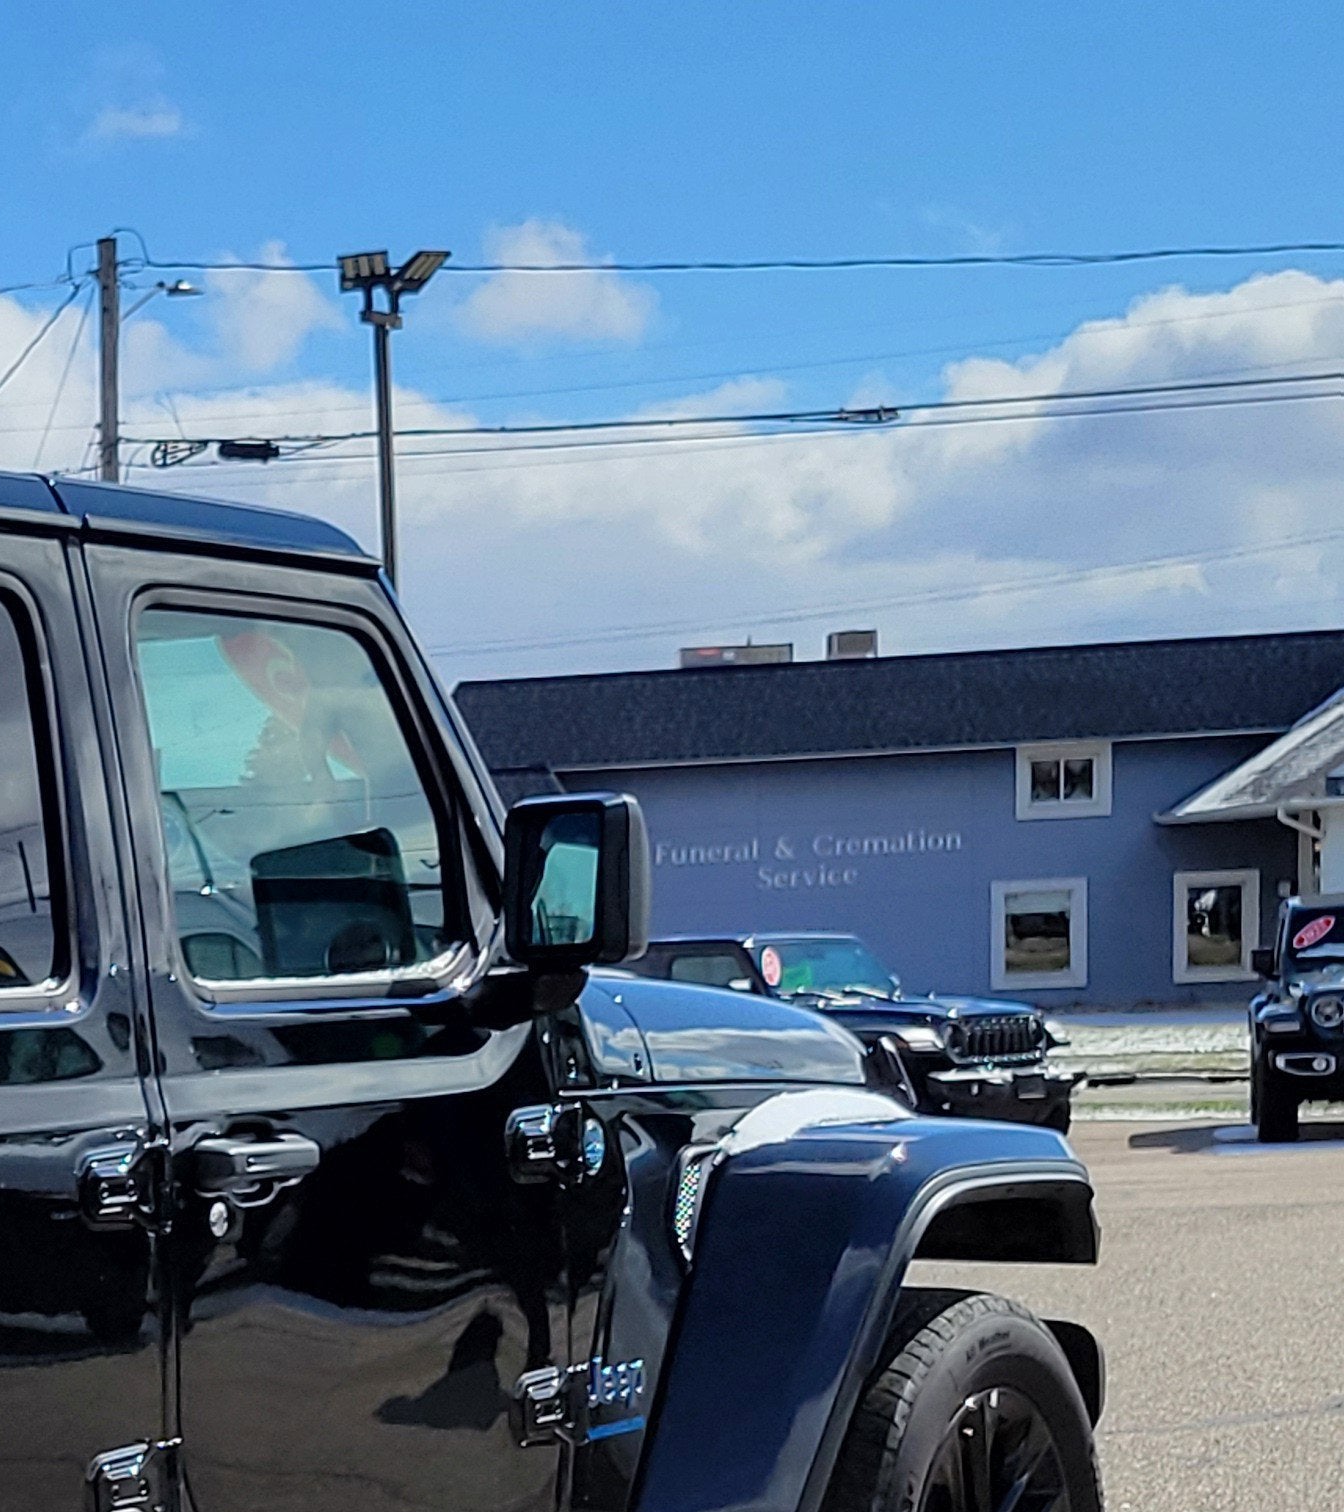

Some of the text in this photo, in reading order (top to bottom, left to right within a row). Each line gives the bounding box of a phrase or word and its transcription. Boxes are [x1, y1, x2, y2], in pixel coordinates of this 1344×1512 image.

[654, 829, 962, 866] Funeral & Cremation
[758, 863, 858, 889] Service
[587, 1356, 646, 1409] Jeep
